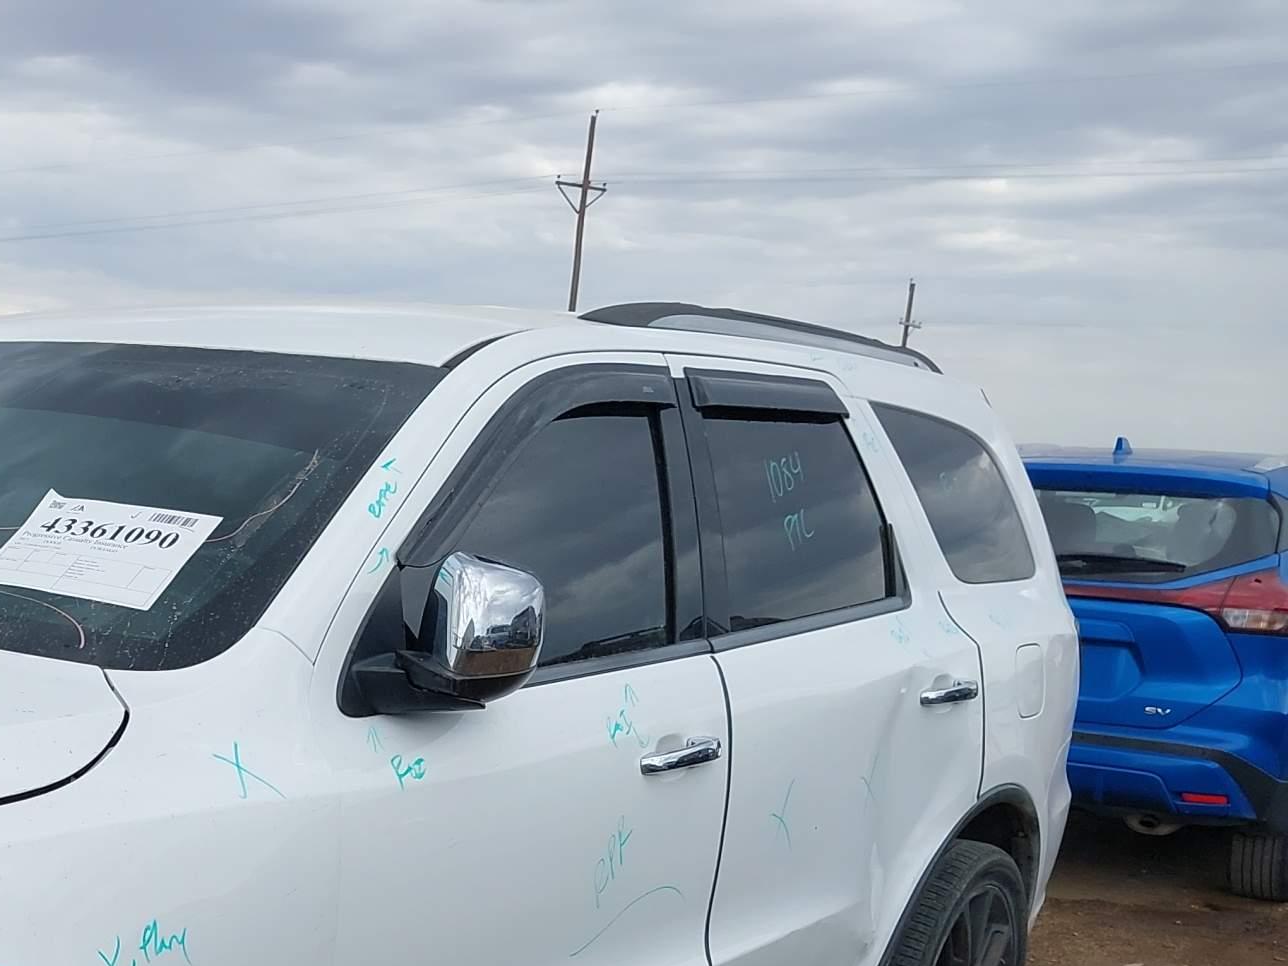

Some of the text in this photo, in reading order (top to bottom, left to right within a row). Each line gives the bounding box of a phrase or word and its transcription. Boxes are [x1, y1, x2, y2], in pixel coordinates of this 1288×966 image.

[762, 450, 804, 503] 1084
[39, 516, 180, 550] 43361090
[1144, 705, 1172, 716] SV
